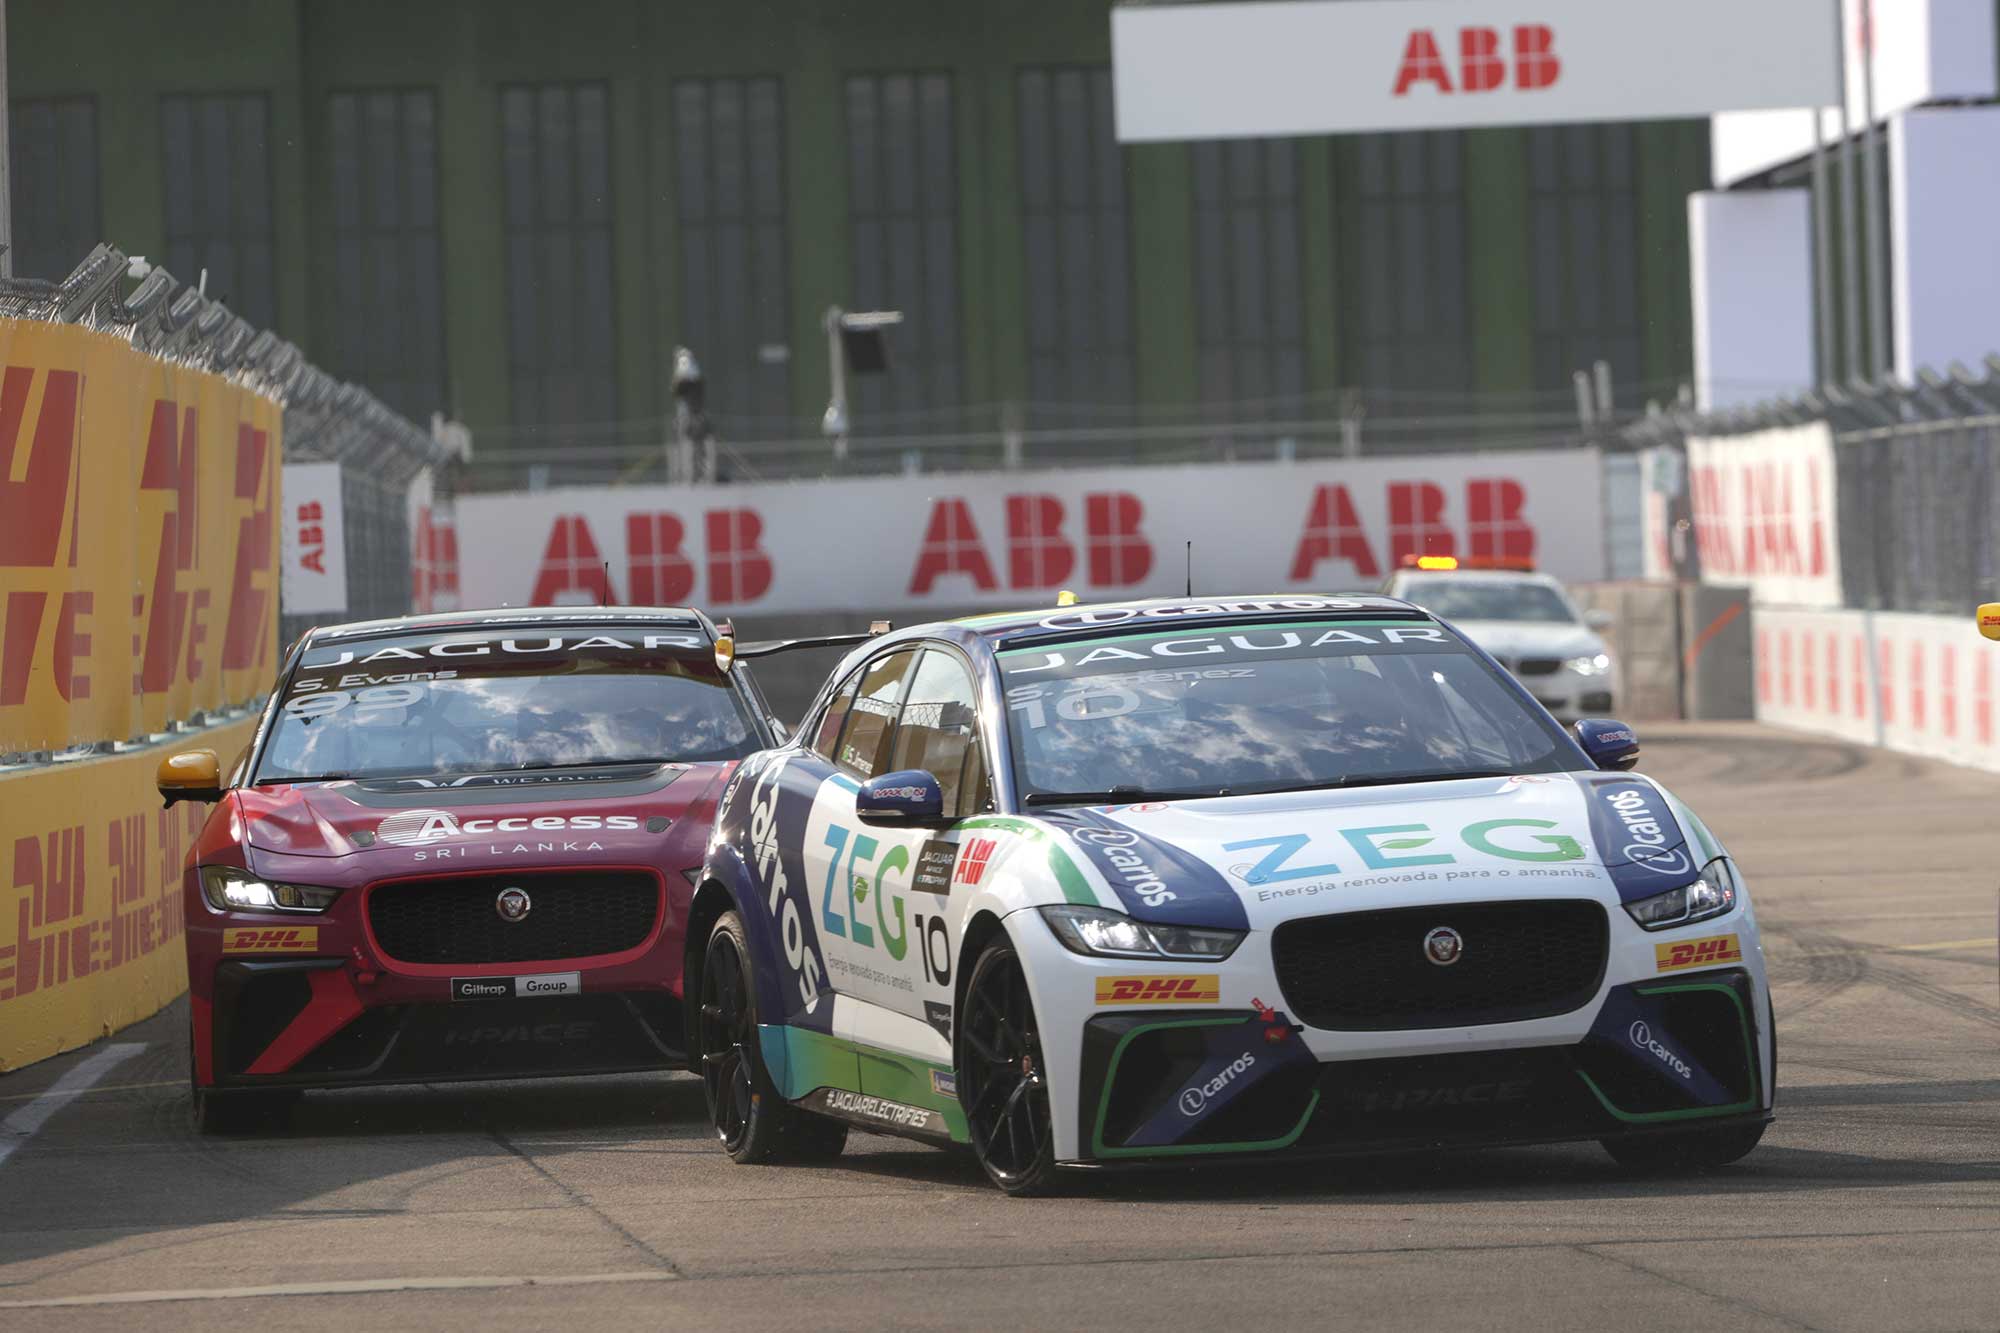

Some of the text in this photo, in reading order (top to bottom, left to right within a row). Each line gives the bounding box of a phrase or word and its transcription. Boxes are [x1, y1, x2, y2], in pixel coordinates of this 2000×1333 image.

[1392, 24, 1561, 97] ABB
[298, 499, 326, 575] ABB
[907, 494, 1154, 594] ABB
[1289, 477, 1538, 577] ABB
[530, 509, 774, 606] ABB
[303, 635, 702, 669] JAGUAR
[1009, 628, 1450, 673] JAGUAR
[293, 670, 458, 693] S. Evans
[1006, 684, 1054, 703] S.
[285, 685, 426, 720] 99
[1010, 690, 1141, 728] 10
[415, 813, 639, 838] Access
[414, 840, 604, 861] SRI LANKA
[1222, 818, 1587, 887] ZEG
[822, 823, 910, 962] ZEG
[1258, 880, 1337, 901] Energia
[1343, 870, 1430, 889] renovada
[1446, 867, 1492, 881] para
[1499, 868, 1512, 878] o
[233, 931, 304, 949] DHL
[914, 913, 951, 987] 10
[1669, 938, 1732, 967] DHL
[460, 980, 568, 997] Giltrap Group
[1111, 979, 1202, 1000] DHL
[826, 1088, 930, 1128] #JAGUARELECTRIFIES
